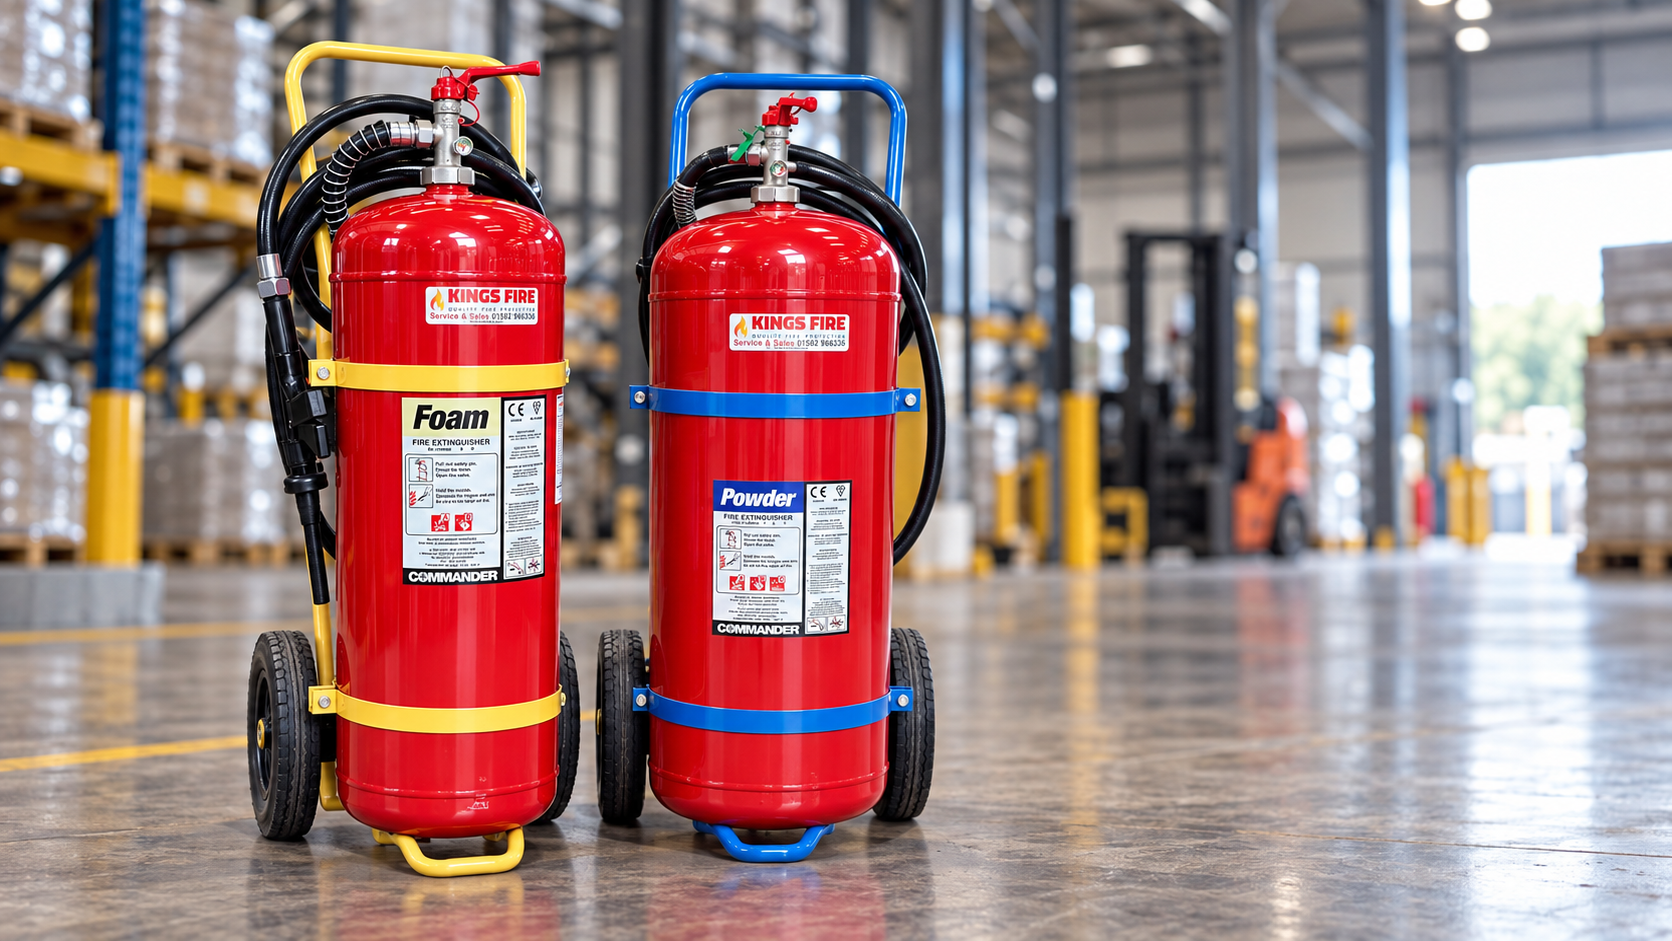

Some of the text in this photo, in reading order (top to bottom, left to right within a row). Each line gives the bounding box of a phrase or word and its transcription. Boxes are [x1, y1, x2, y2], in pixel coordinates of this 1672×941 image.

[448, 288, 536, 304] KINGS FIRE
[752, 316, 846, 330] KINGS FIRE
[413, 404, 490, 430] Foam
[720, 488, 796, 507] Powder
[408, 571, 498, 582] COMMANDER
[717, 624, 800, 634] COMMANDER
